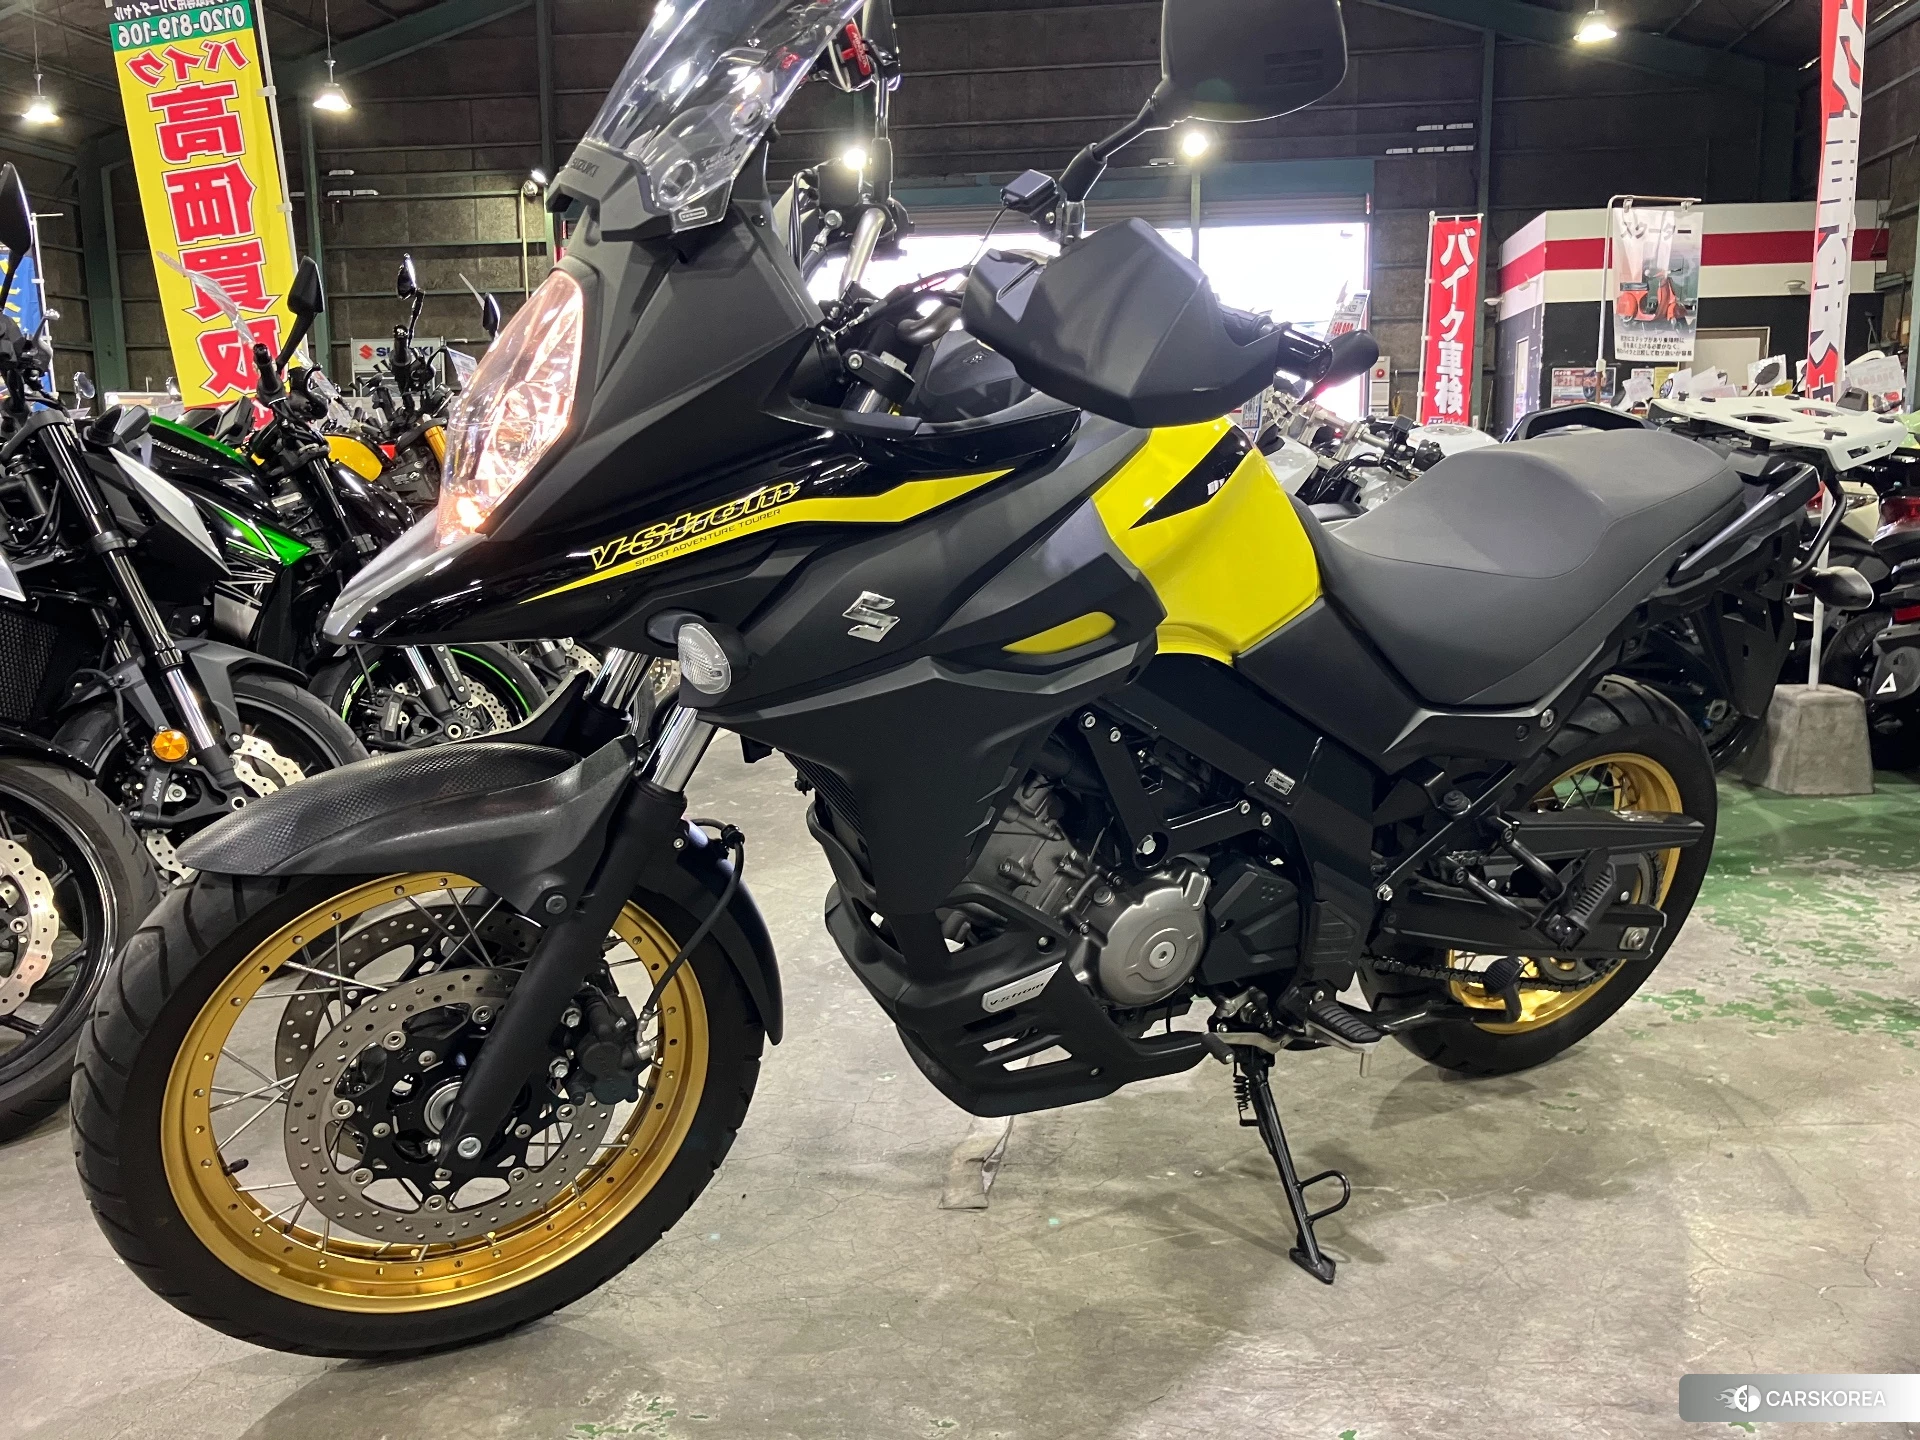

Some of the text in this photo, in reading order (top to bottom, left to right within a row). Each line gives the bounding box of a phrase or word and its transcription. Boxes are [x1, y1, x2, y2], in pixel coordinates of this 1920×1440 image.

[570, 158, 600, 177] SUZUKI
[1434, 227, 1476, 415] バイク車検
[376, 346, 433, 357] SKI
[591, 482, 800, 570] V-Strom
[634, 508, 781, 567] SPORT ADVENTURE TOURER
